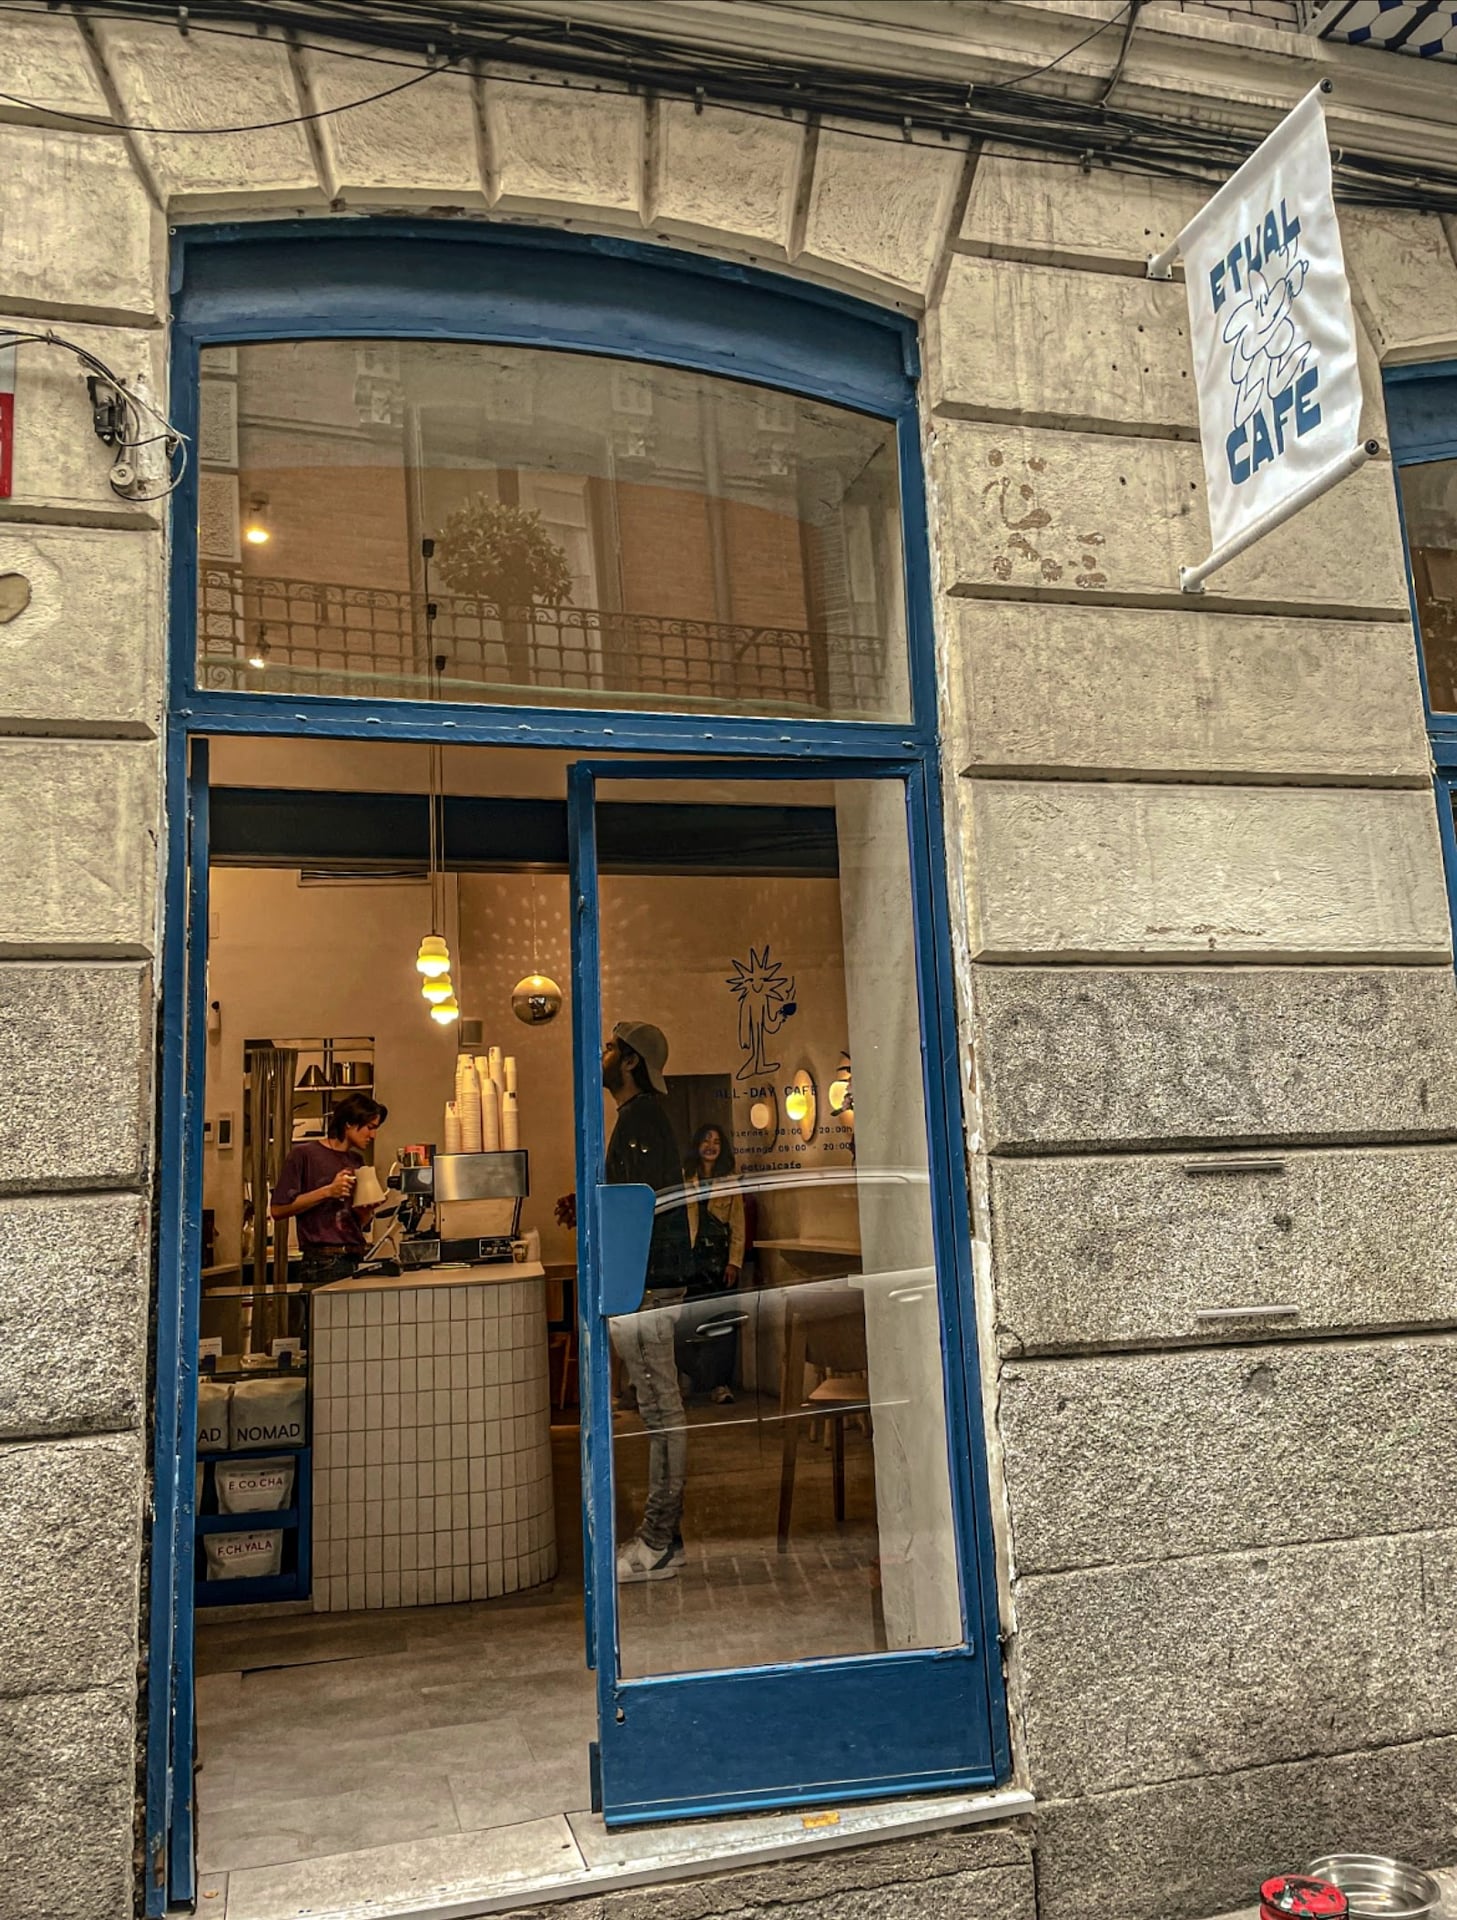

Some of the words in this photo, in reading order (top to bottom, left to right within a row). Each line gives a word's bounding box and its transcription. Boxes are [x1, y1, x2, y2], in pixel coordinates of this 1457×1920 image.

[1209, 197, 1301, 314] ETUAL
[1226, 366, 1322, 485] CAFE
[714, 1085, 775, 1099] ALL-DAY
[236, 1423, 300, 1442] NOMAD
